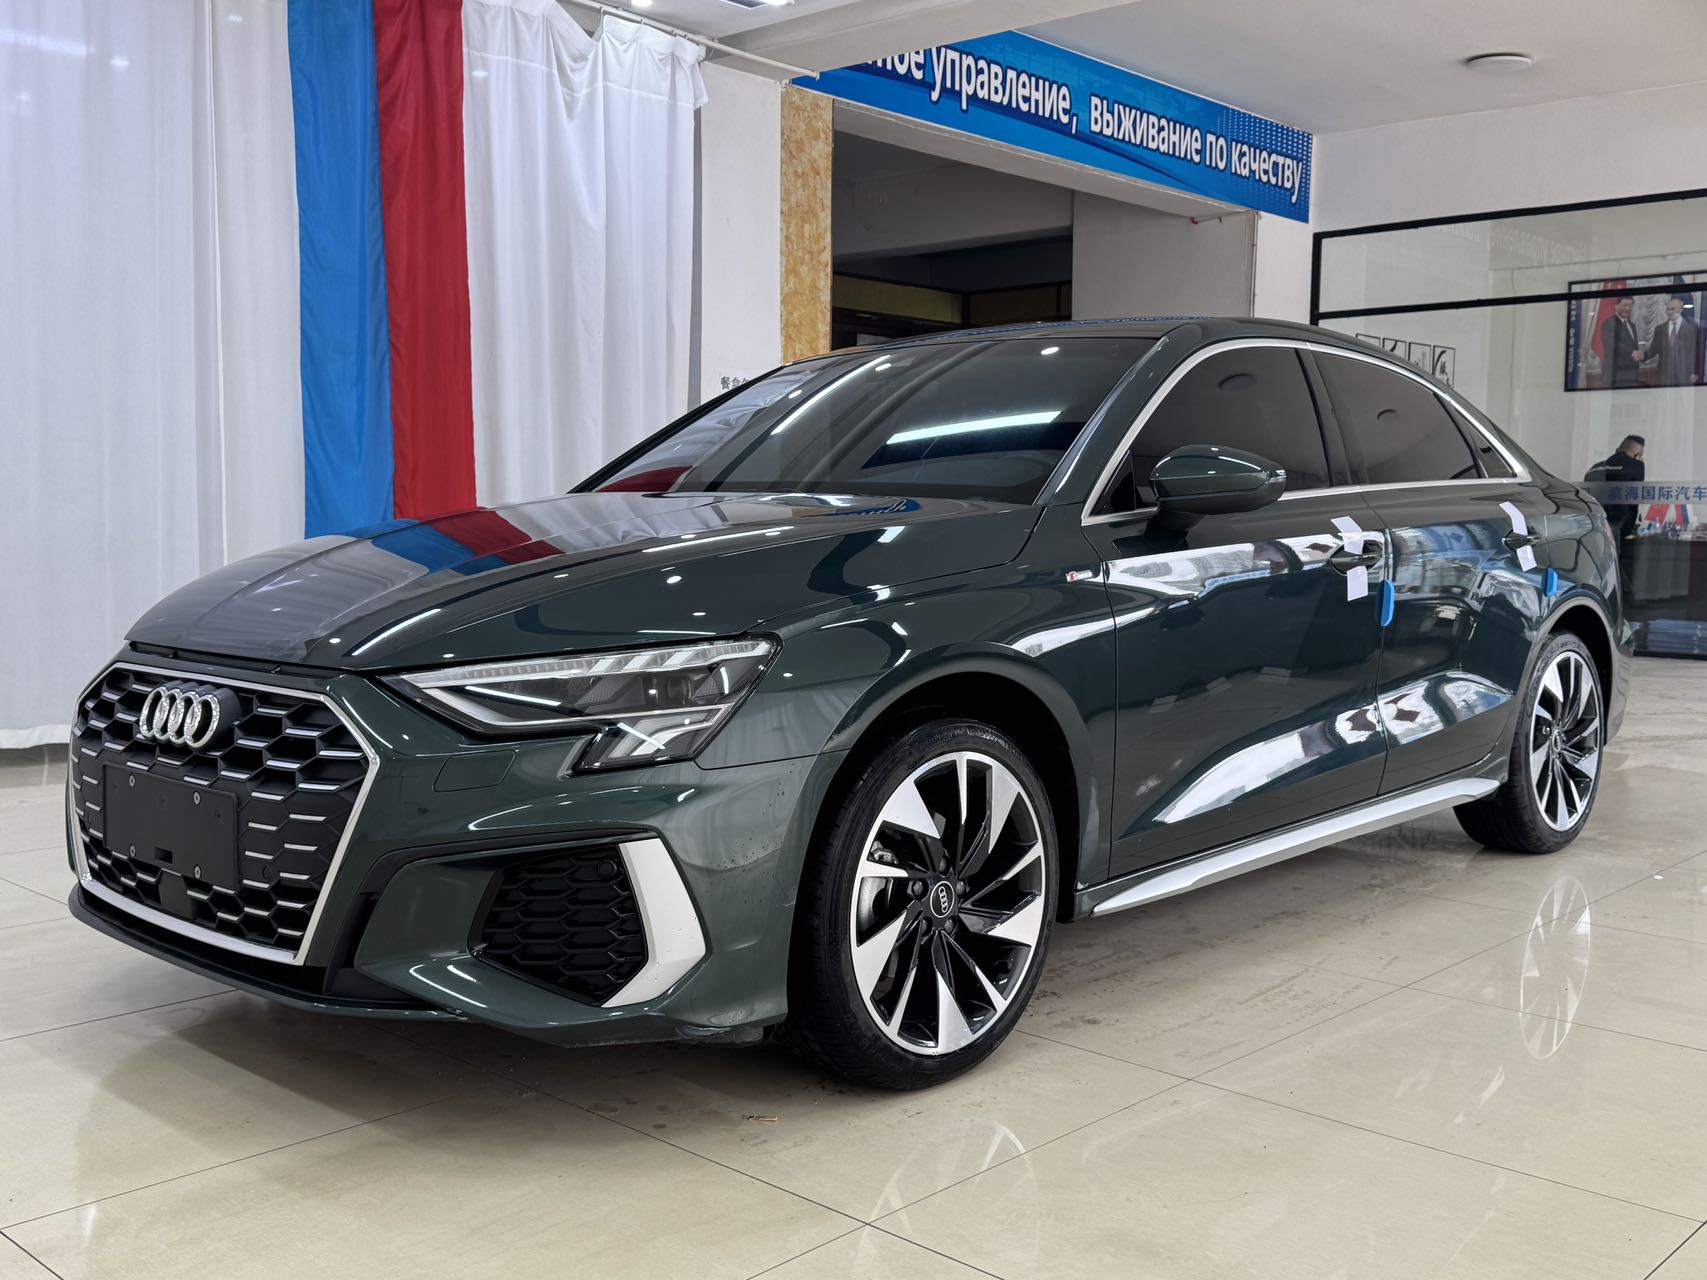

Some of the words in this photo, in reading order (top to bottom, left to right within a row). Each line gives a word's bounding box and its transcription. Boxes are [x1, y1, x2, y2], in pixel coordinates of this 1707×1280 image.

[931, 47, 1077, 134] управление,
[1091, 96, 1202, 163] выживание
[1206, 133, 1227, 170] по
[1231, 141, 1302, 204] качеству
